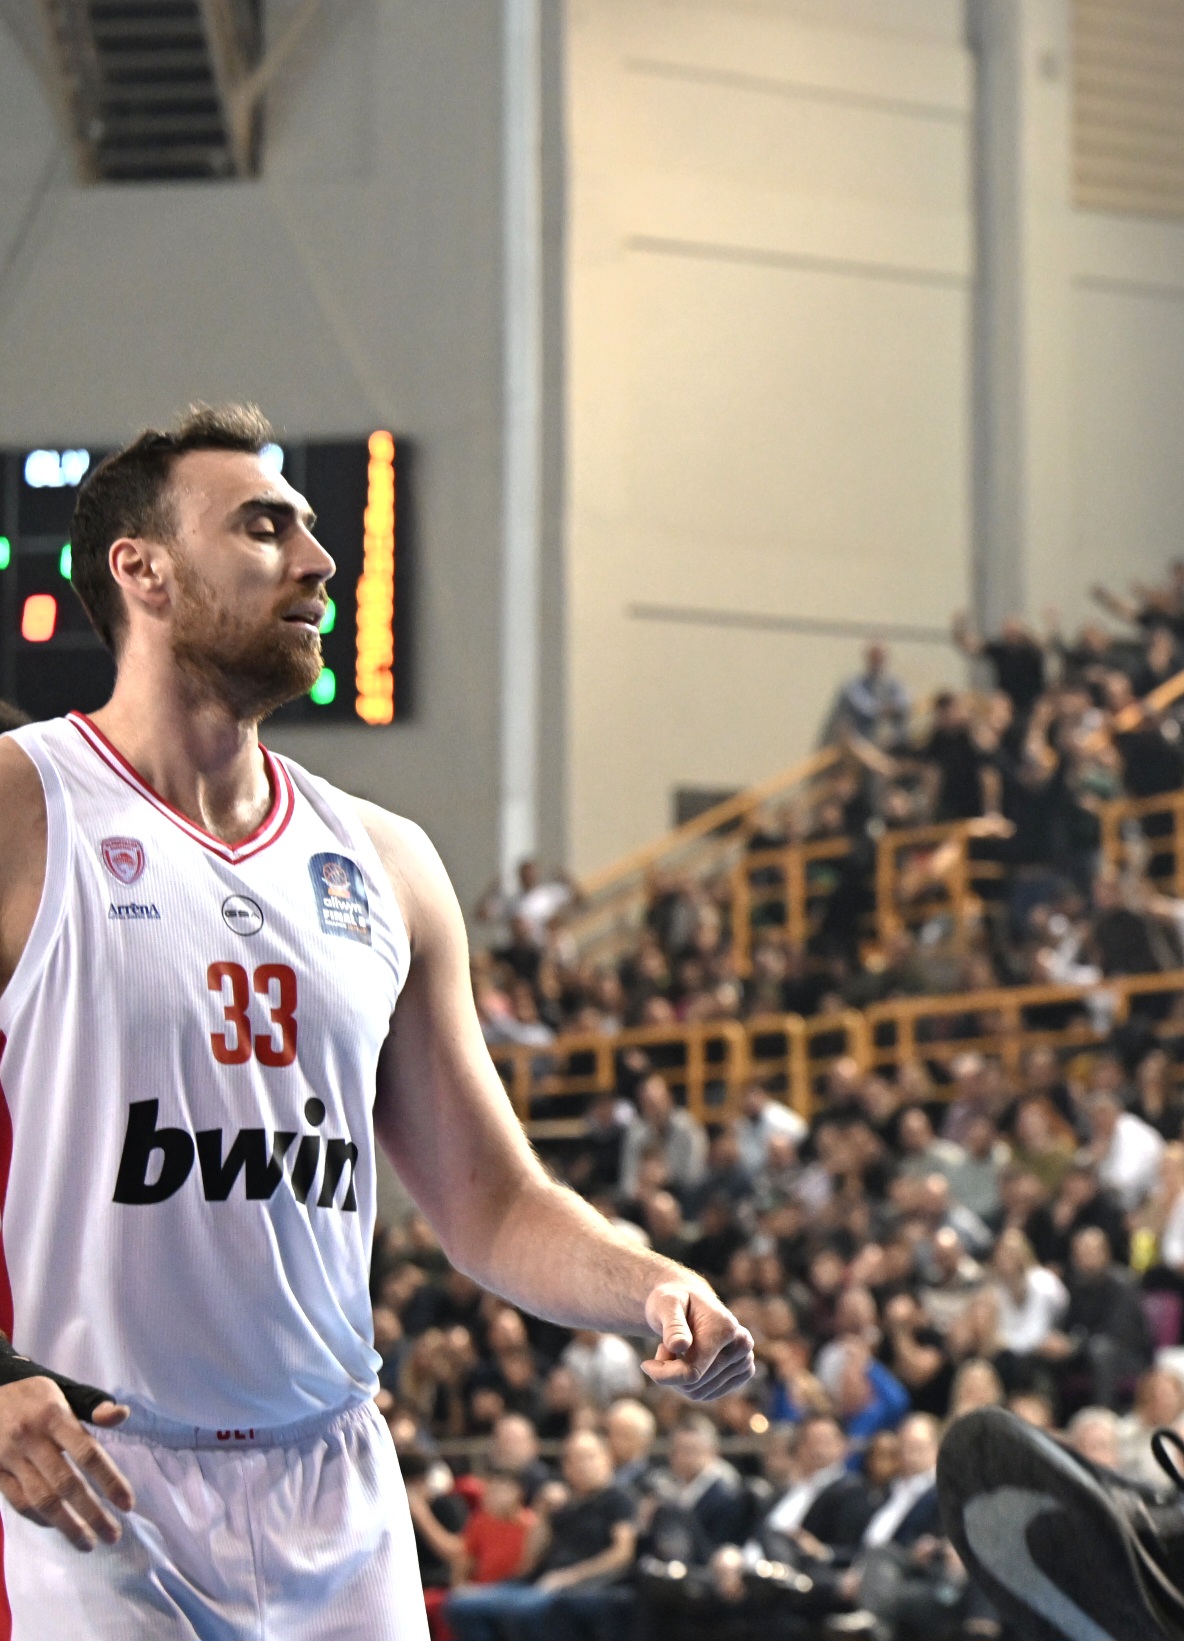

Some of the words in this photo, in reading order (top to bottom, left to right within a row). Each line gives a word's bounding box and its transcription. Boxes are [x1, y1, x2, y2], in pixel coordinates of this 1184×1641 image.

[323, 909, 358, 924] FINAL
[207, 961, 299, 1067] 33
[112, 1097, 359, 1212] bwin
